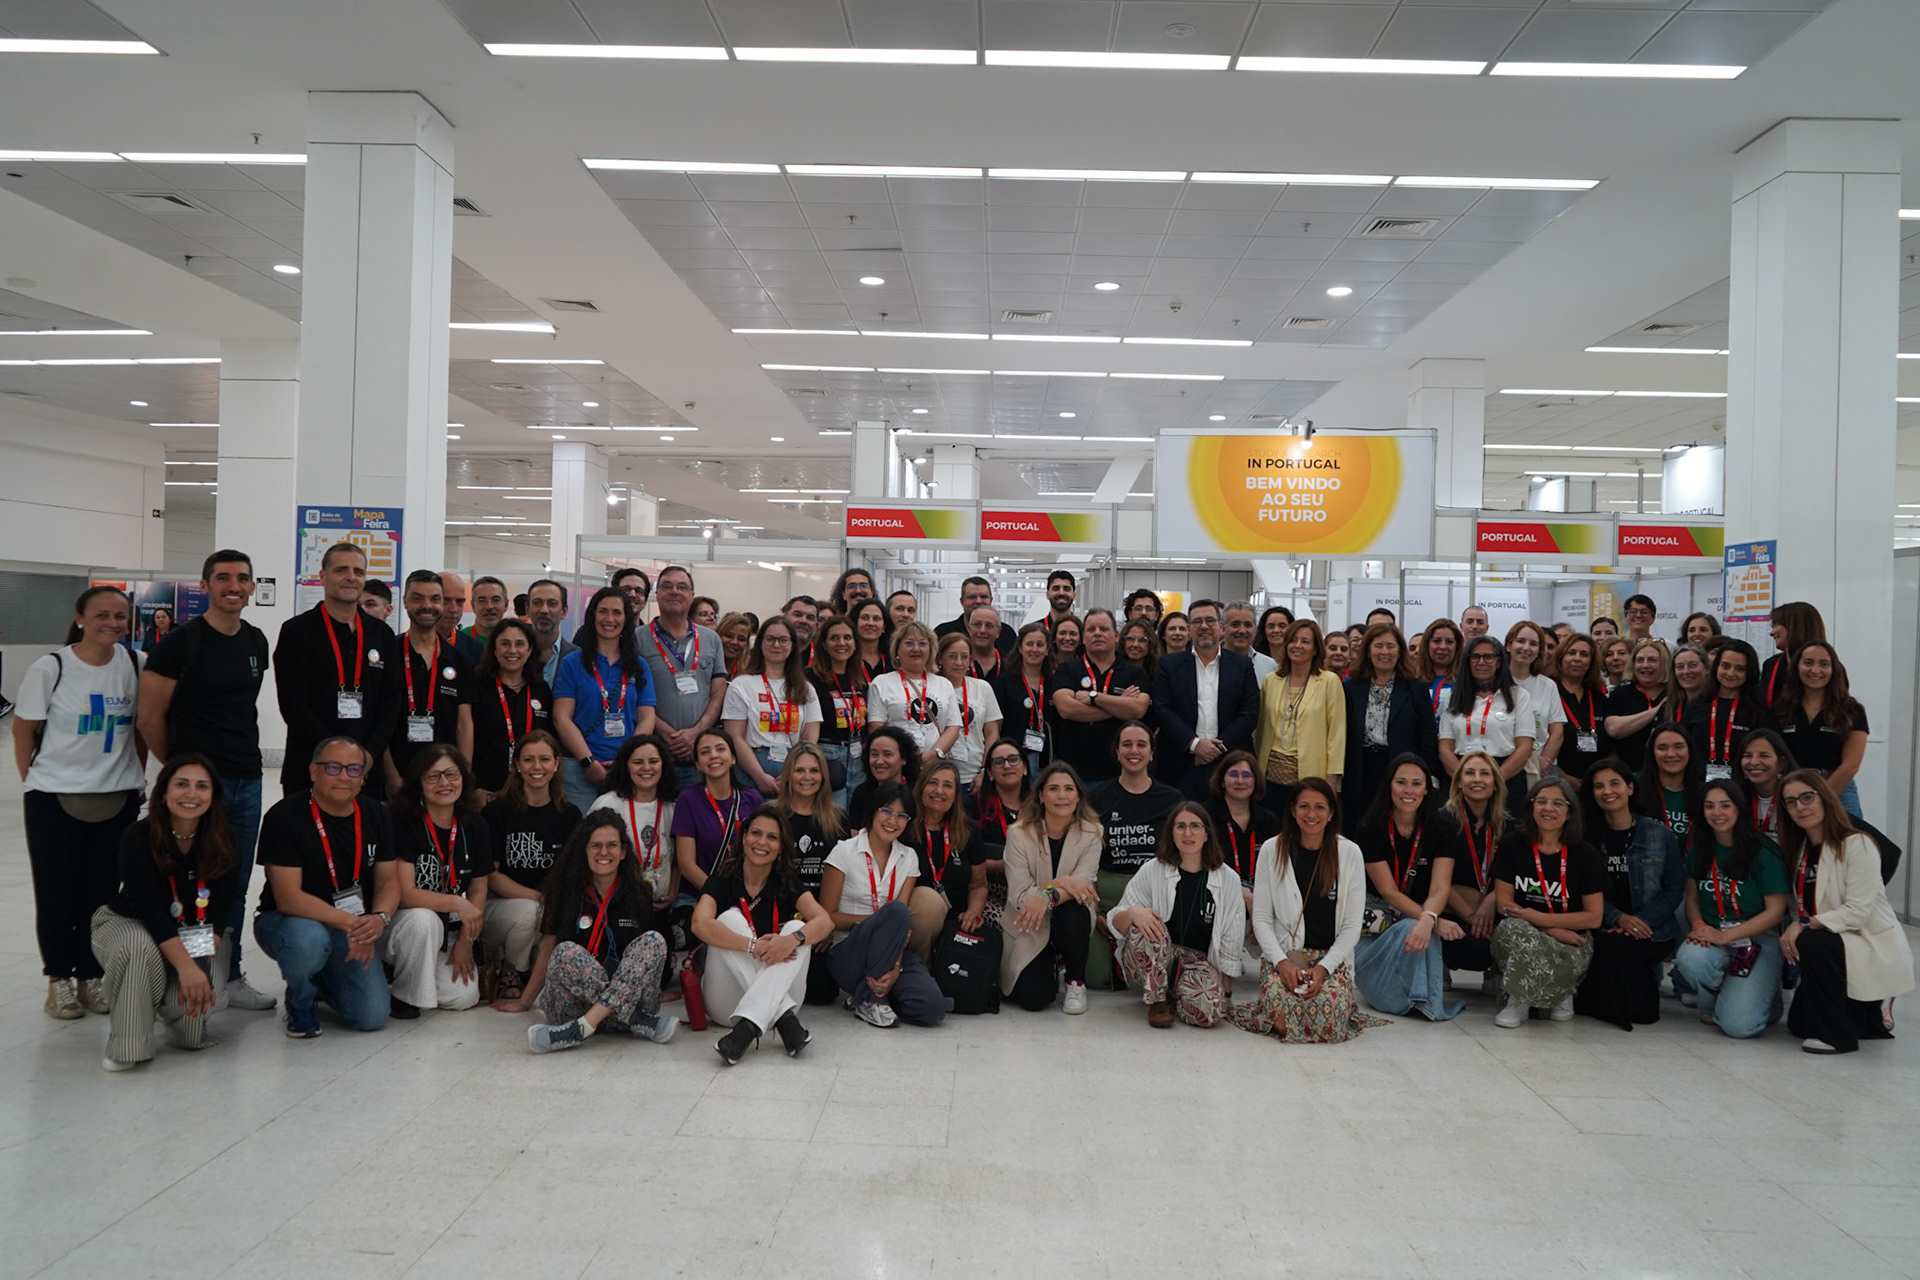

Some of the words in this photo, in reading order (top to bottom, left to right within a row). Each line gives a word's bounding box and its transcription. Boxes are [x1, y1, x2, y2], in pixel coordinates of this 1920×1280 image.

[1247, 458, 1261, 469] IN
[1266, 458, 1341, 469] PORTUGAL
[1246, 476, 1282, 490] BEM
[1286, 477, 1341, 491] VINDO
[1261, 493, 1287, 506] AO
[1290, 493, 1324, 506] SEU
[353, 509, 385, 521] Mapa
[1258, 509, 1327, 523] FUTURO
[363, 518, 390, 529] Feira
[851, 518, 904, 528] PORTUGAL
[986, 521, 1039, 532] PORTUGAL
[1481, 532, 1537, 543] PORTUGAL
[1623, 535, 1679, 546] PORTUGAL
[1756, 552, 1770, 563] Feira
[1109, 825, 1155, 836] univer-
[511, 832, 536, 842] UNI
[1109, 833, 1156, 847] sidade
[1111, 847, 1128, 858] de
[1515, 875, 1570, 899] NOVA
